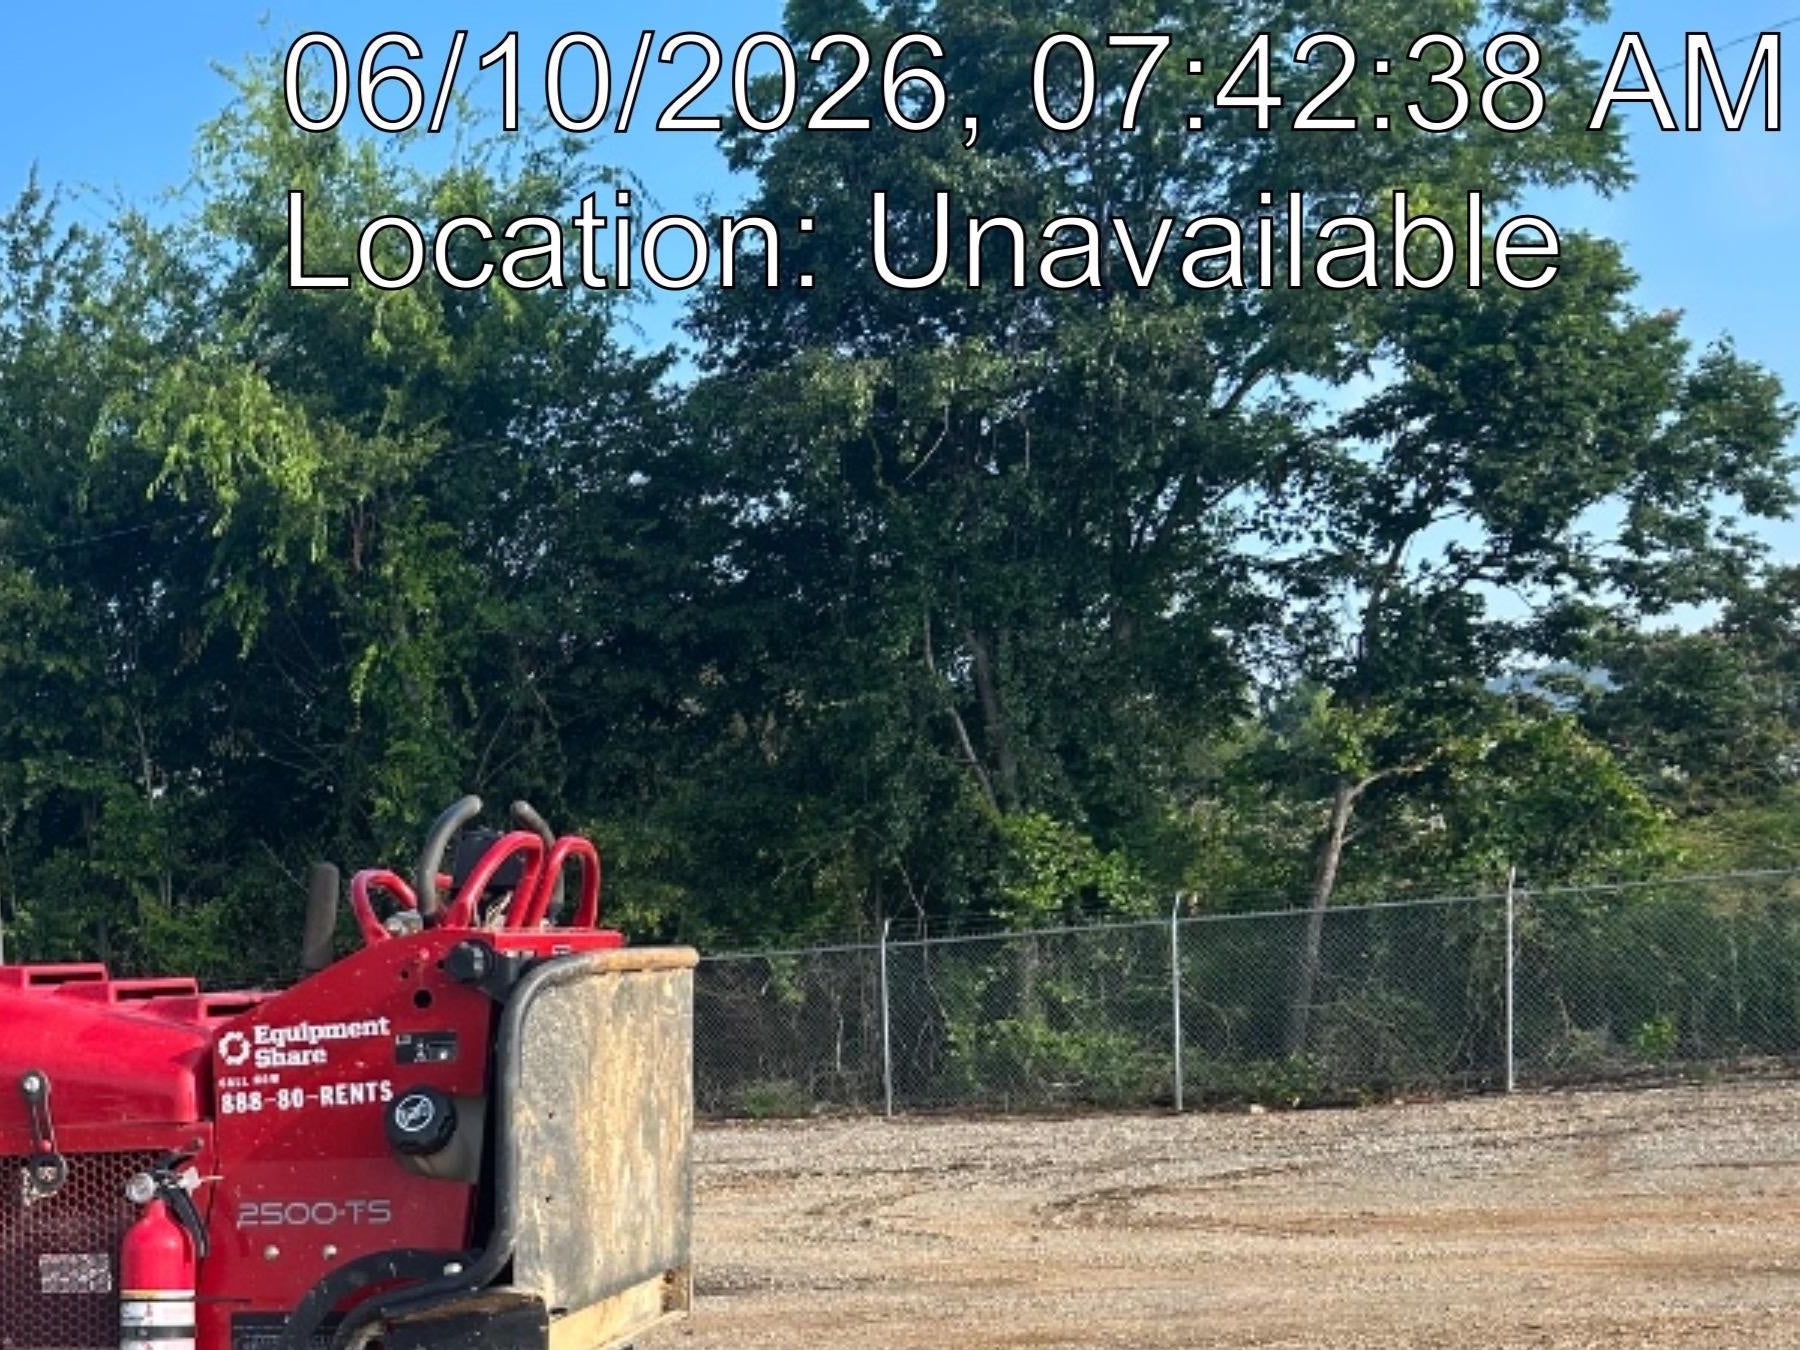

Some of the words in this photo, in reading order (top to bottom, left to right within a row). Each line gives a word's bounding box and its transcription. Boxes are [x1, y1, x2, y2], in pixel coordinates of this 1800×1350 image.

[253, 1016, 391, 1047] Equipment
[253, 1047, 328, 1068] Share
[220, 1080, 394, 1114] 888-80-RENTS
[237, 1200, 392, 1226] 2500-TS
